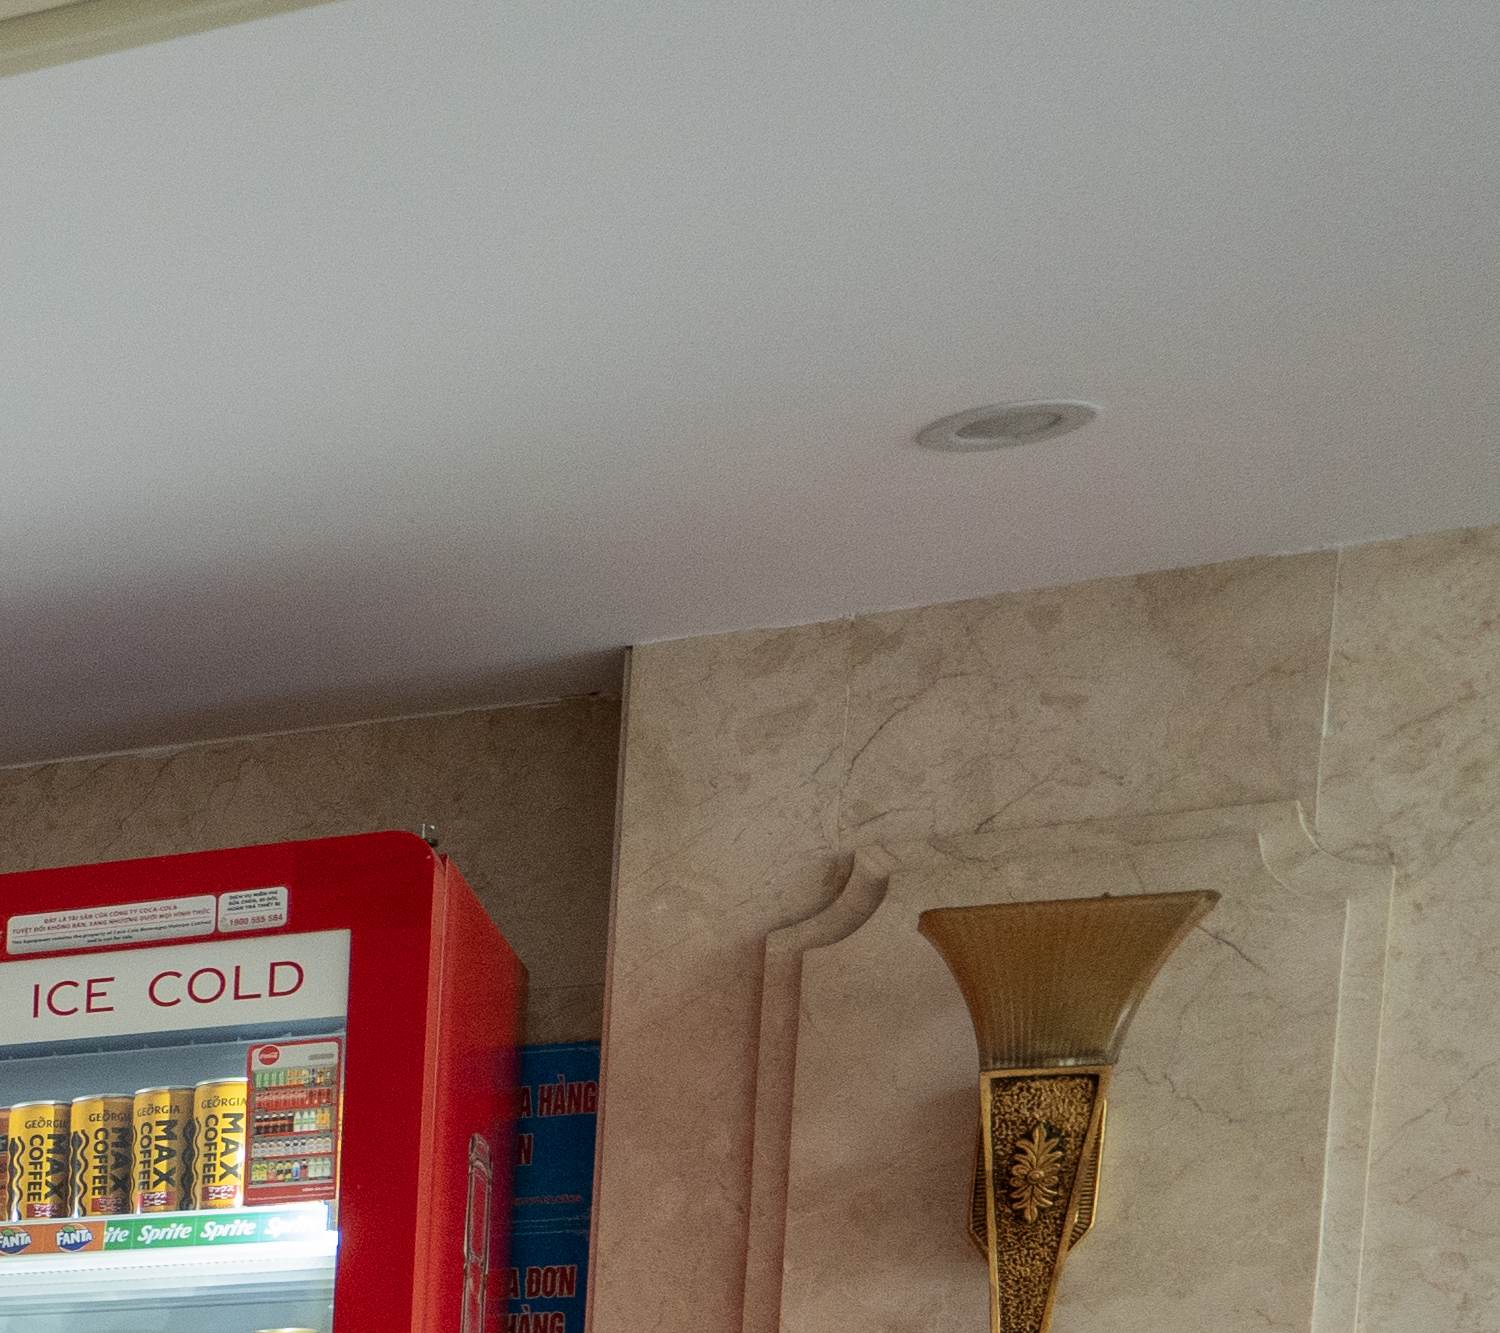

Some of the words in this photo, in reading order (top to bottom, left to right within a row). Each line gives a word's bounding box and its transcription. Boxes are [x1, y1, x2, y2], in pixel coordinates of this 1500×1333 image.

[32, 976, 115, 1018] ICE
[148, 960, 304, 1008] COLD
[537, 1073, 598, 1117] HÀNG
[28, 1134, 44, 1202] COFFEE
[45, 1133, 61, 1201] MAX
[91, 1127, 109, 1196] COFFEE
[110, 1126, 131, 1191] MAX
[138, 1122, 151, 1190] COFFEE
[152, 1119, 178, 1189] MAX
[202, 1113, 219, 1184] COFFEE
[219, 1112, 245, 1182] MAX
[55, 1228, 94, 1247] FANTA
[137, 1223, 192, 1245] Sprite
[200, 1218, 257, 1243] Sprite
[526, 1263, 577, 1299] ĐƠN
